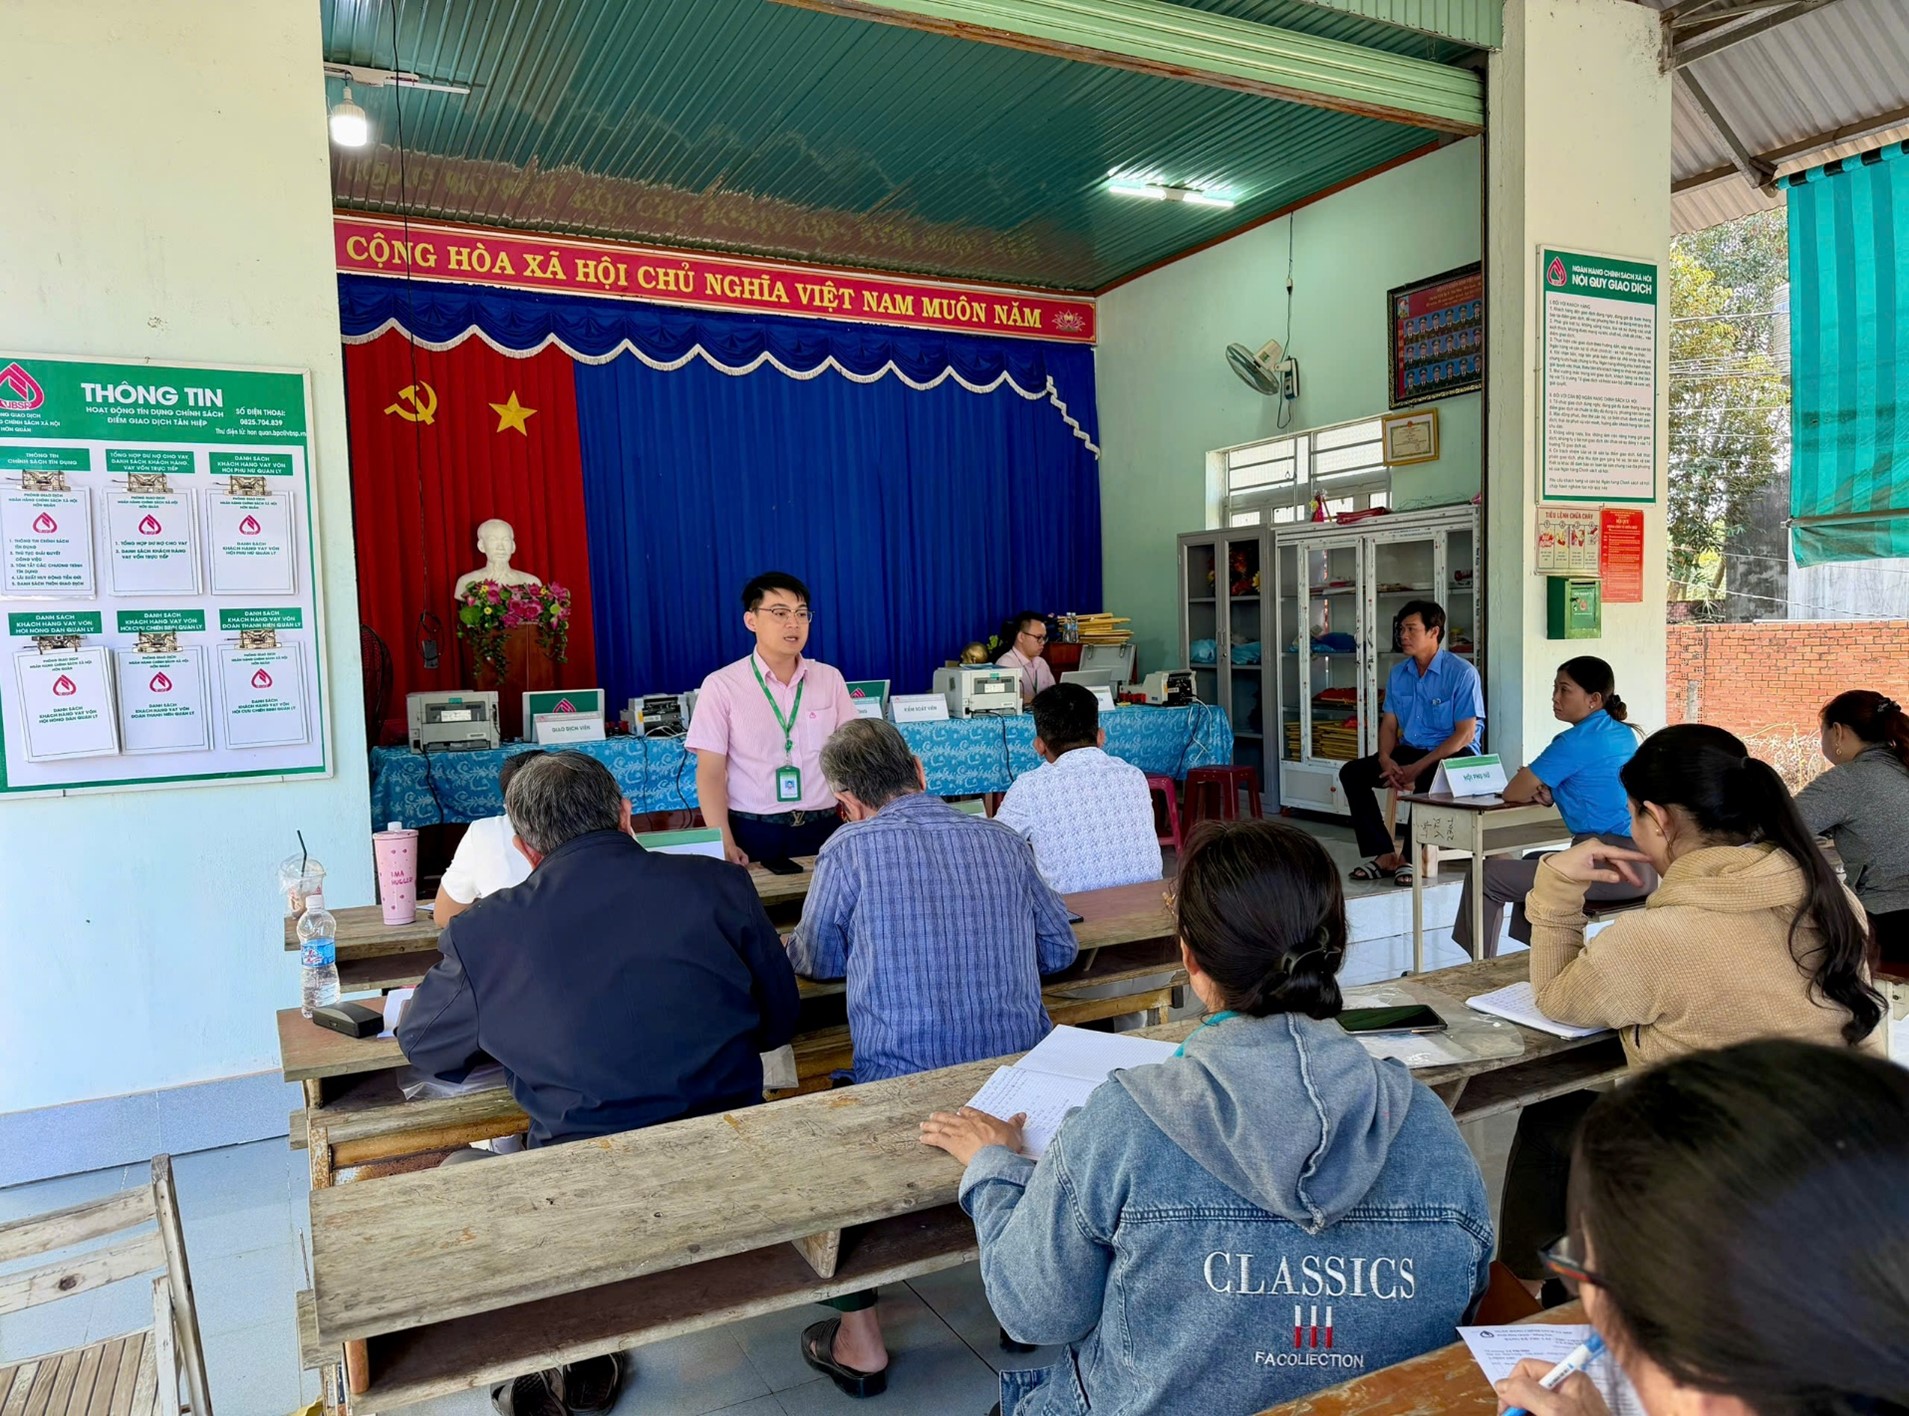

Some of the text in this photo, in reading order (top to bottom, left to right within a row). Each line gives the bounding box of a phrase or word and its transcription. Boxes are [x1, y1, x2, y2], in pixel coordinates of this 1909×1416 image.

[346, 232, 1042, 328] CỘNG HÒA XÃ HỘI CHỦ NGHĨA VIỆT NAM MUÔN NĂM
[1572, 274, 1652, 294] NỘI QUY GIAO DỊCH
[80, 380, 223, 408] THÔNG TIN
[108, 414, 126, 424] ĐIỂM
[111, 406, 135, 416] ĐỘNG
[176, 408, 200, 416] CHÍNH
[1204, 1252, 1415, 1300] CLASSICS
